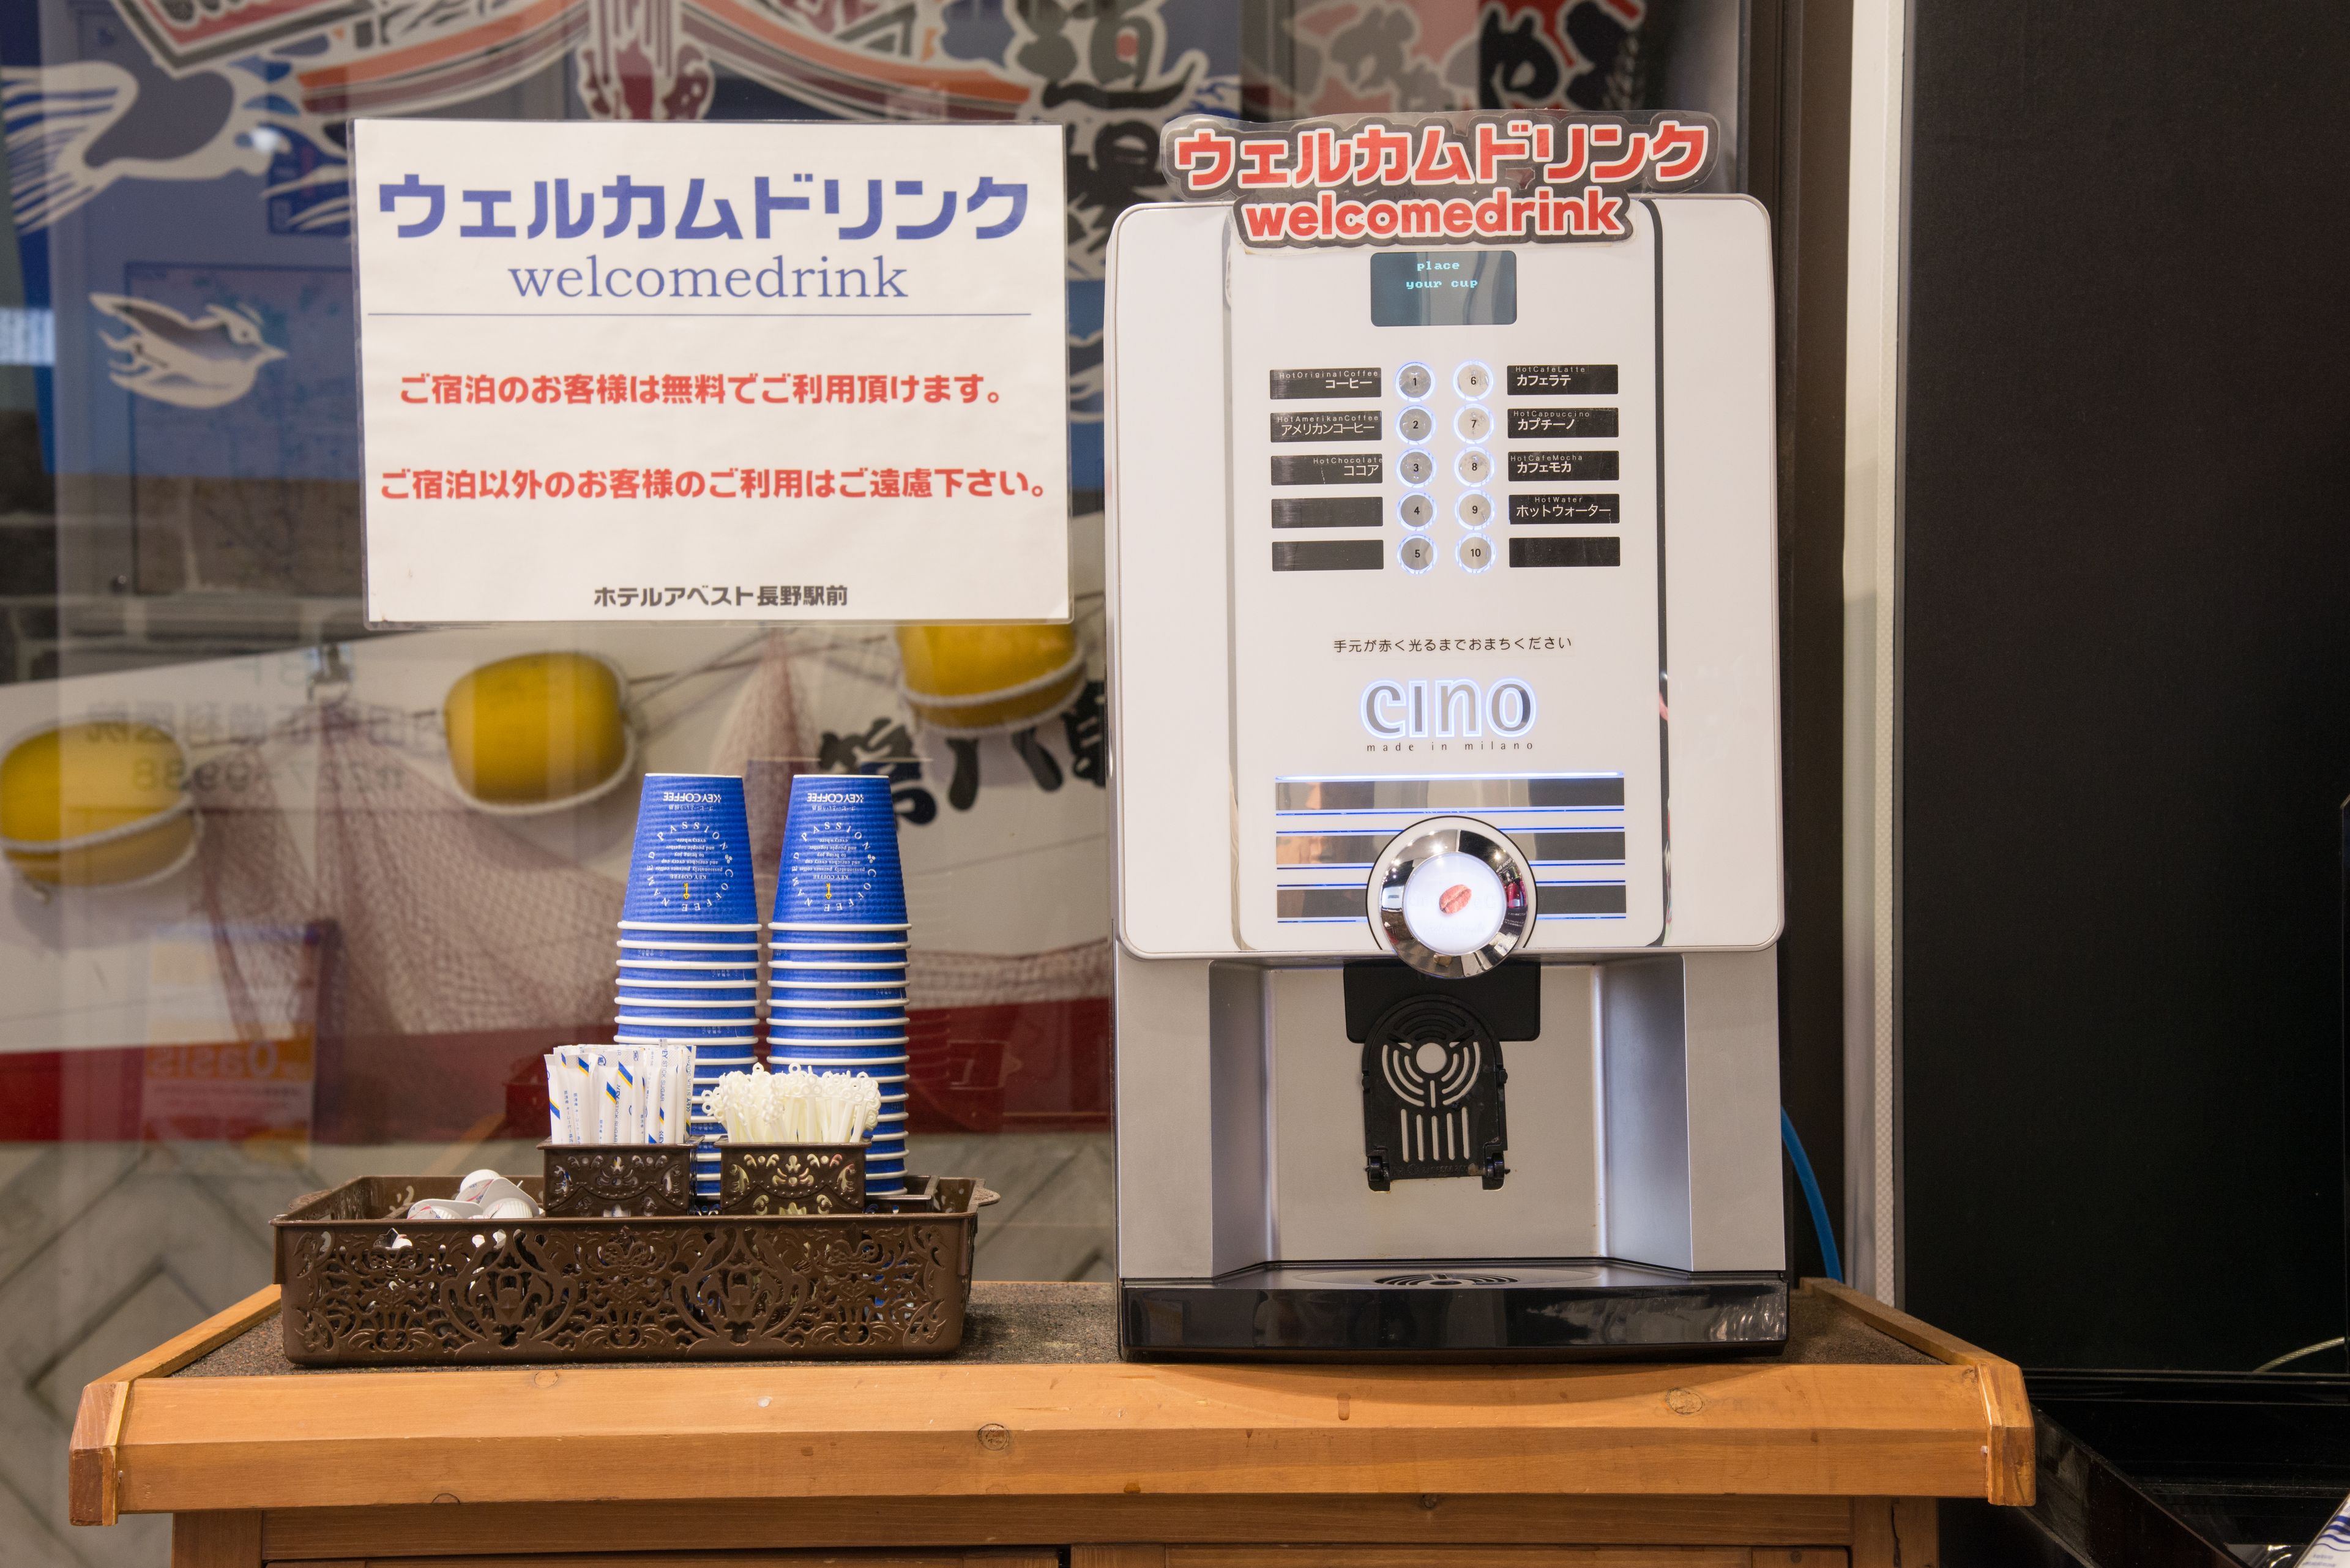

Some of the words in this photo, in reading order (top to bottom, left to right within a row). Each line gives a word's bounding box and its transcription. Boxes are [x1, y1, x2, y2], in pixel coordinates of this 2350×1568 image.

[1174, 123, 1709, 187] ウェルカムドリンク
[379, 173, 1028, 240] ウェルカムドリンク
[1244, 186, 1625, 241] welcomedrink
[1417, 259, 1460, 272] place
[507, 254, 909, 298] welcomedrink
[1405, 278, 1442, 291] your
[1451, 278, 1479, 290] cup
[1280, 370, 1378, 379] HotOriginalCoffee
[1471, 376, 1477, 385] 6
[1517, 374, 1572, 387] カフェラテ
[1325, 378, 1373, 389] コーヒー
[1414, 378, 1417, 386] 1
[400, 373, 1000, 405] ご宿泊のお客様は無料でご利用頂けます。
[1281, 422, 1375, 436] アメリカンコーヒー
[1413, 420, 1419, 429] 2
[1471, 419, 1477, 428] 7
[1518, 417, 1575, 431] カプチーノ
[1344, 465, 1379, 477] ココア
[1413, 463, 1419, 472] 3
[1472, 462, 1477, 471] 8
[1517, 461, 1572, 474] カフェモカ
[381, 467, 1044, 500] ご宿泊以外のお客様のご利用はご遠慮下さい。
[1414, 506, 1420, 515] 4
[1472, 506, 1478, 514] 9
[1516, 504, 1611, 518] ホットウォーター
[1414, 549, 1420, 558] 5
[1471, 548, 1481, 557] 10
[594, 584, 848, 607] ホテルアベスト長野駅前
[1334, 637, 1572, 653] 手元が赤く光るまでおまちください
[1362, 679, 1536, 737] cino
[1367, 742, 1414, 752] made
[1431, 741, 1447, 751] in
[1464, 741, 1533, 750] milano
